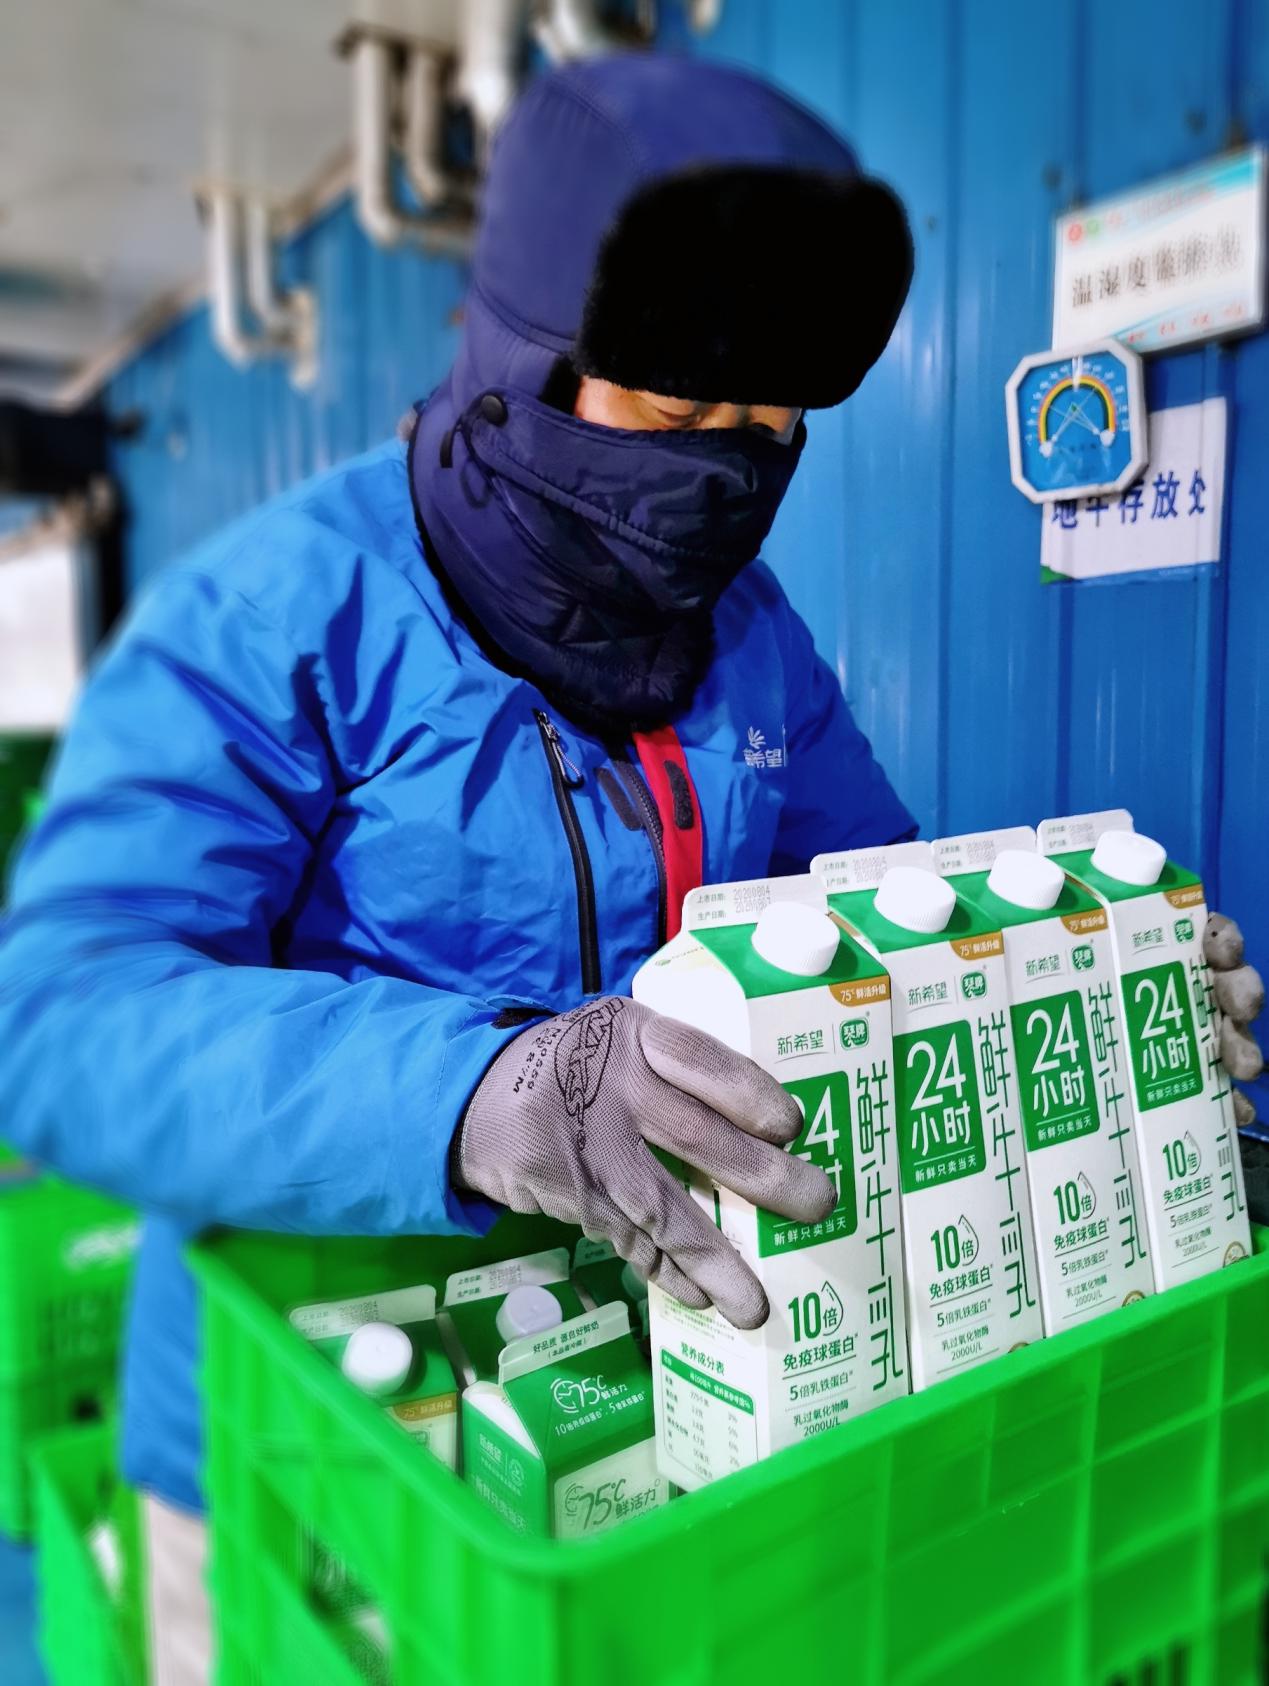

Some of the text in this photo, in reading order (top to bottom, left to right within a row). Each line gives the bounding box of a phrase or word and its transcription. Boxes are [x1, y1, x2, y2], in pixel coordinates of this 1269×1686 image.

[907, 981, 948, 1006] 新希望
[1134, 972, 1185, 1040] 24
[776, 1029, 824, 1056] 新希望
[1026, 1001, 1080, 1075] 24
[1143, 1032, 1189, 1080] 小时
[907, 1033, 967, 1111] 24
[1033, 1065, 1085, 1118] 小时
[911, 1100, 971, 1157] 小时
[1037, 1115, 1093, 1142] 新鲜只卖当天
[1088, 980, 1147, 1269] 鲜牛乳
[915, 1154, 977, 1183] 新鲜只卖当天
[978, 1010, 1036, 1318] 鲜牛乳
[773, 1216, 847, 1247] 新鲜只卖当天
[856, 1060, 904, 1391] 鲜牛乳
[788, 1291, 839, 1344] 10倍
[783, 1336, 855, 1372] 免疫球蛋白
[803, 1416, 841, 1438] 2000U/L
